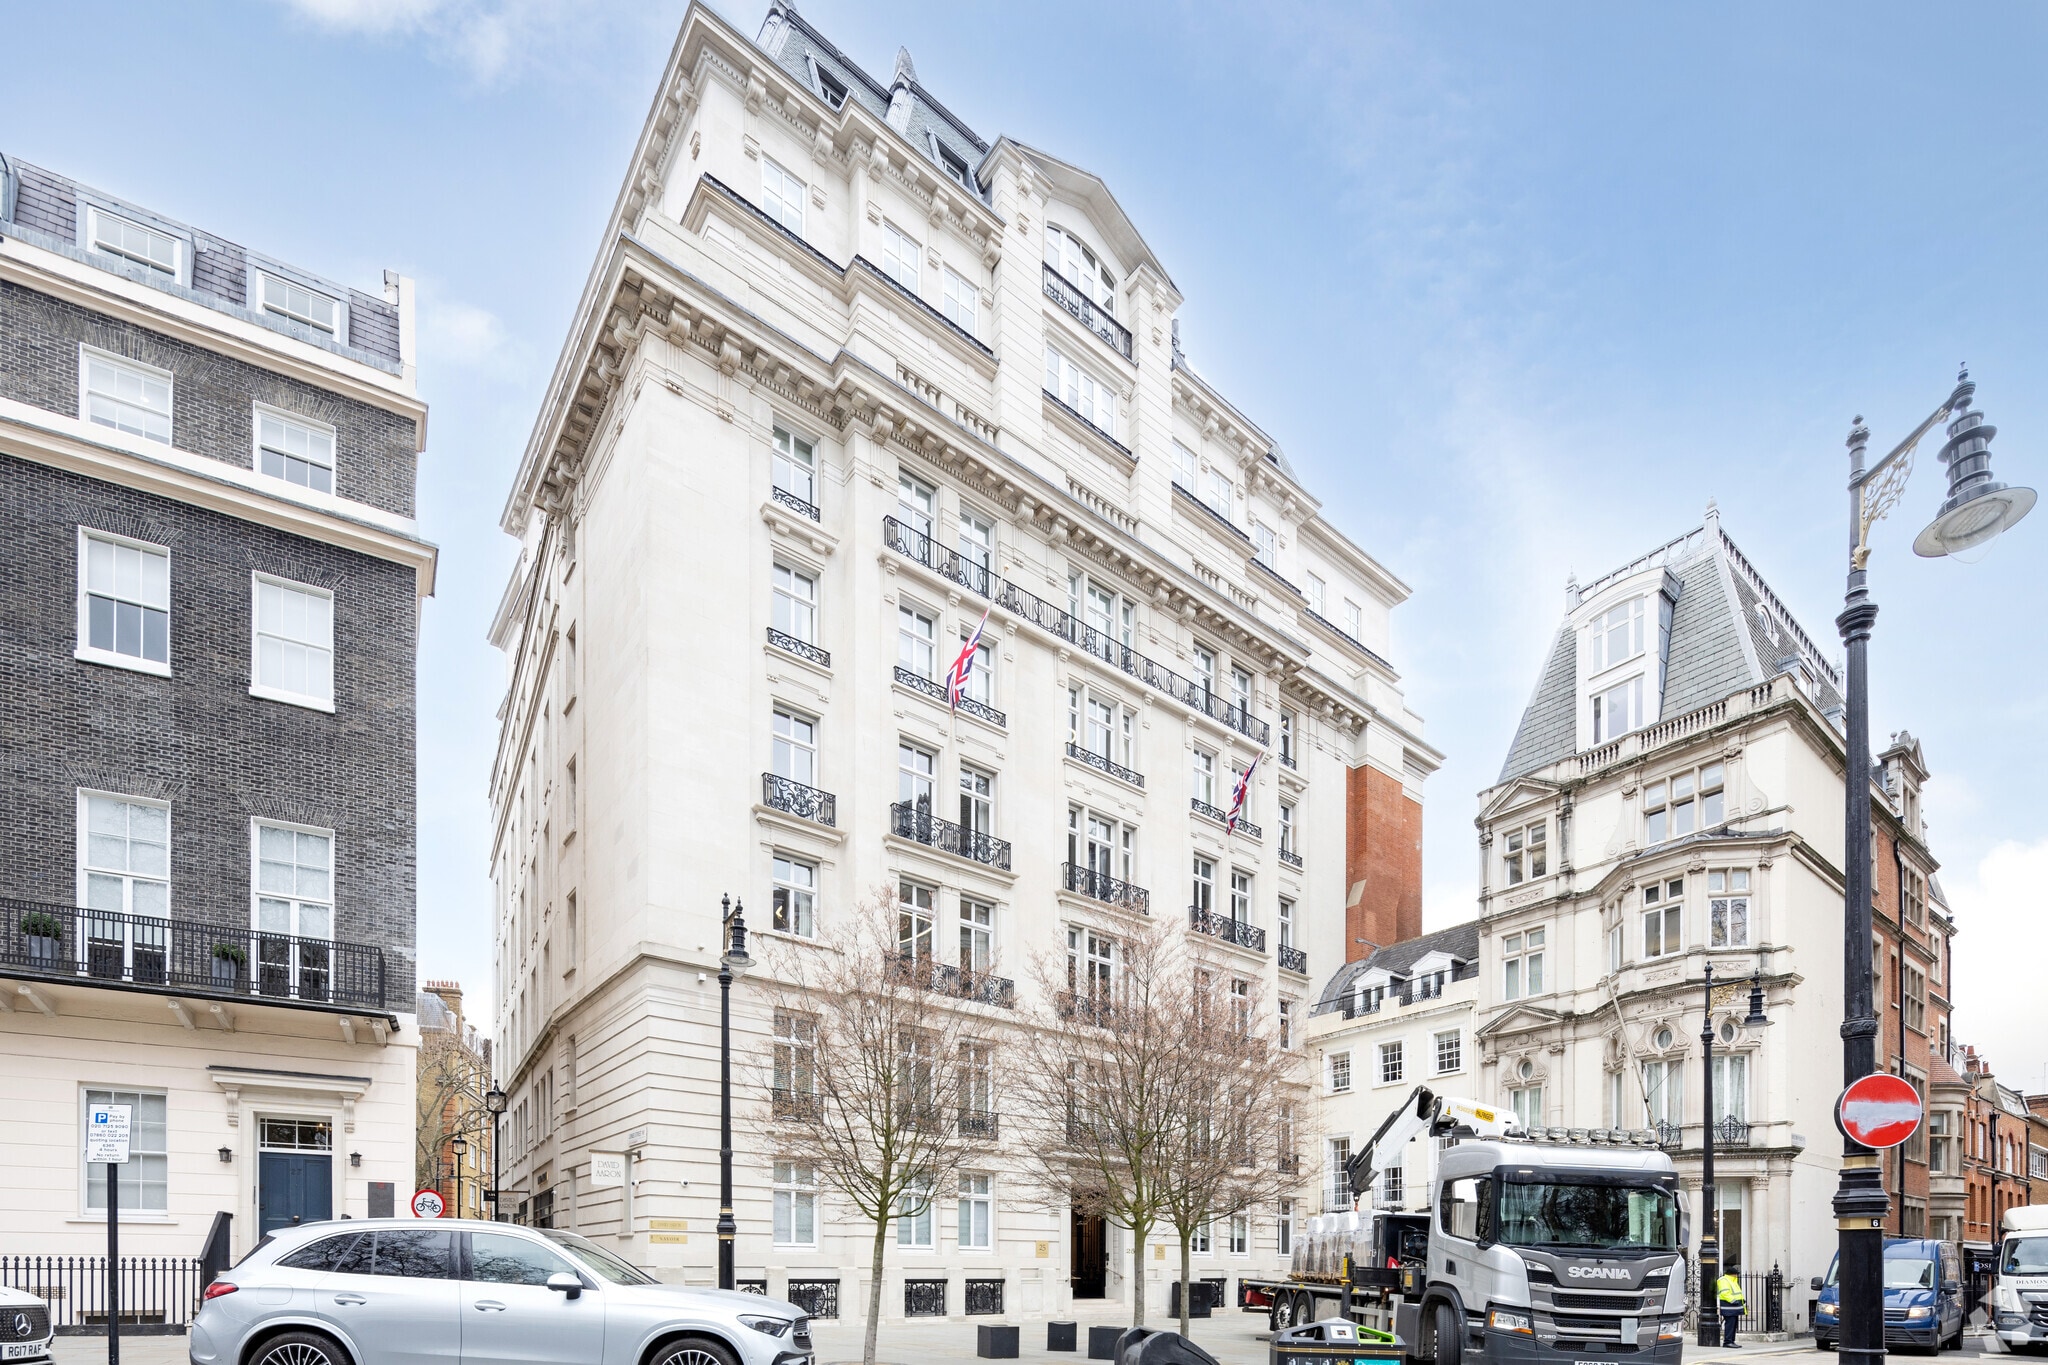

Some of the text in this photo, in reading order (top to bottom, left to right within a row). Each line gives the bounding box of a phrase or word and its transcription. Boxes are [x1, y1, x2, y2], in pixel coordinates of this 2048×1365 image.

[1568, 1266, 1631, 1280] SCANIA
[8, 1344, 42, 1357] RG17 RAF
